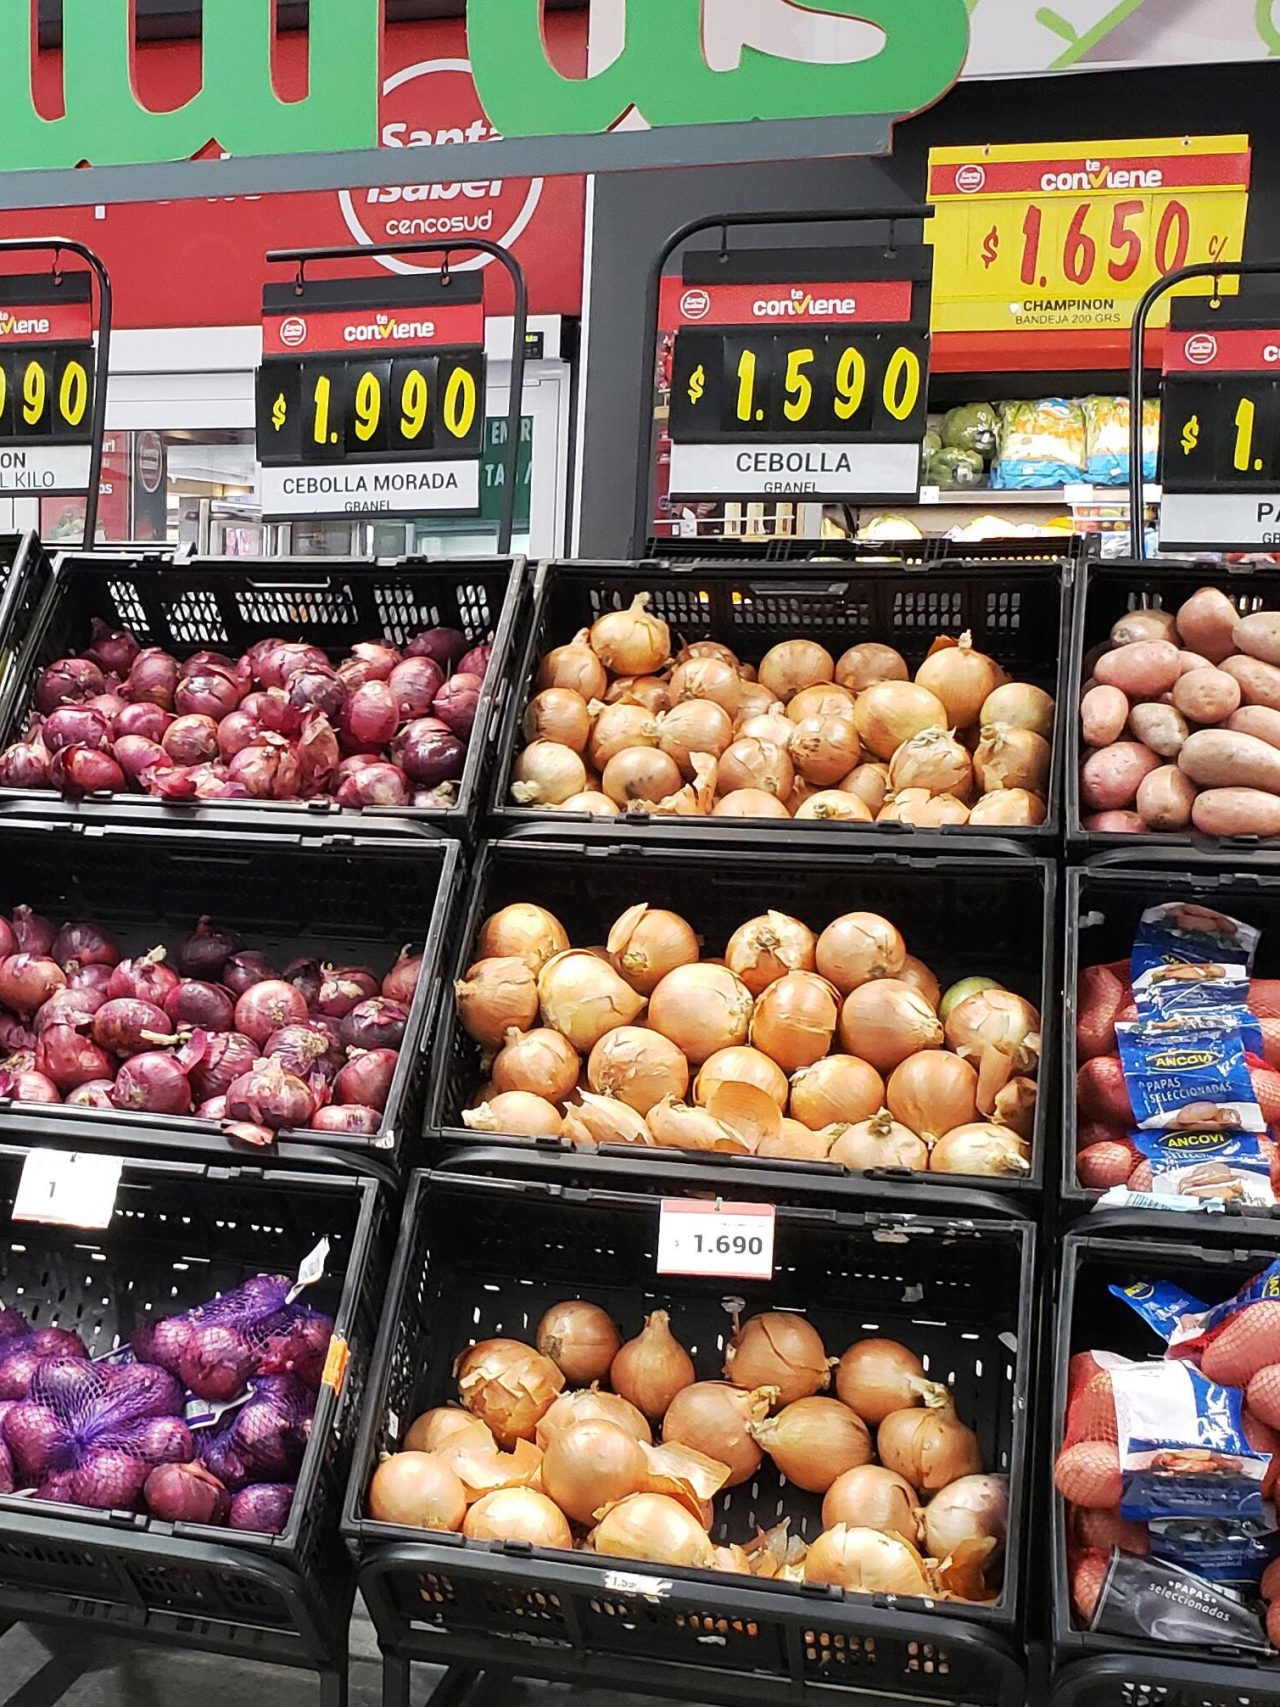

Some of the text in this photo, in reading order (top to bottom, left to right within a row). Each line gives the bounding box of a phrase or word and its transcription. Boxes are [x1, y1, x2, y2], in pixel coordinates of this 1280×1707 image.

[1085, 159, 1100, 172] te
[385, 209, 493, 235] cencosud
[981, 225, 999, 269] $
[1020, 199, 1190, 287] 1.650
[790, 288, 804, 300] te
[1023, 298, 1114, 312] CHAMPINON
[1015, 312, 1121, 325] BANDEJA 200 GRS
[687, 346, 920, 422] $ 1.590
[272, 366, 477, 445] $ 1.990
[1180, 415, 1200, 455] $
[736, 452, 852, 473] CEBOLLA
[15, 471, 55, 488] KILO
[283, 472, 458, 494] CEBOLLA MORADA
[763, 481, 820, 494] GRANEL
[344, 500, 393, 513] GRANEL
[1155, 1053, 1214, 1067] ANCOVI
[1146, 1077, 1181, 1092] PAPAS
[1149, 1081, 1232, 1104] SELECCIONADAS
[1168, 1133, 1225, 1148] ANCOVI
[694, 1234, 763, 1255] 1.690
[1174, 1582, 1212, 1602] PAPAS
[1149, 1583, 1231, 1622] seleccionadas
